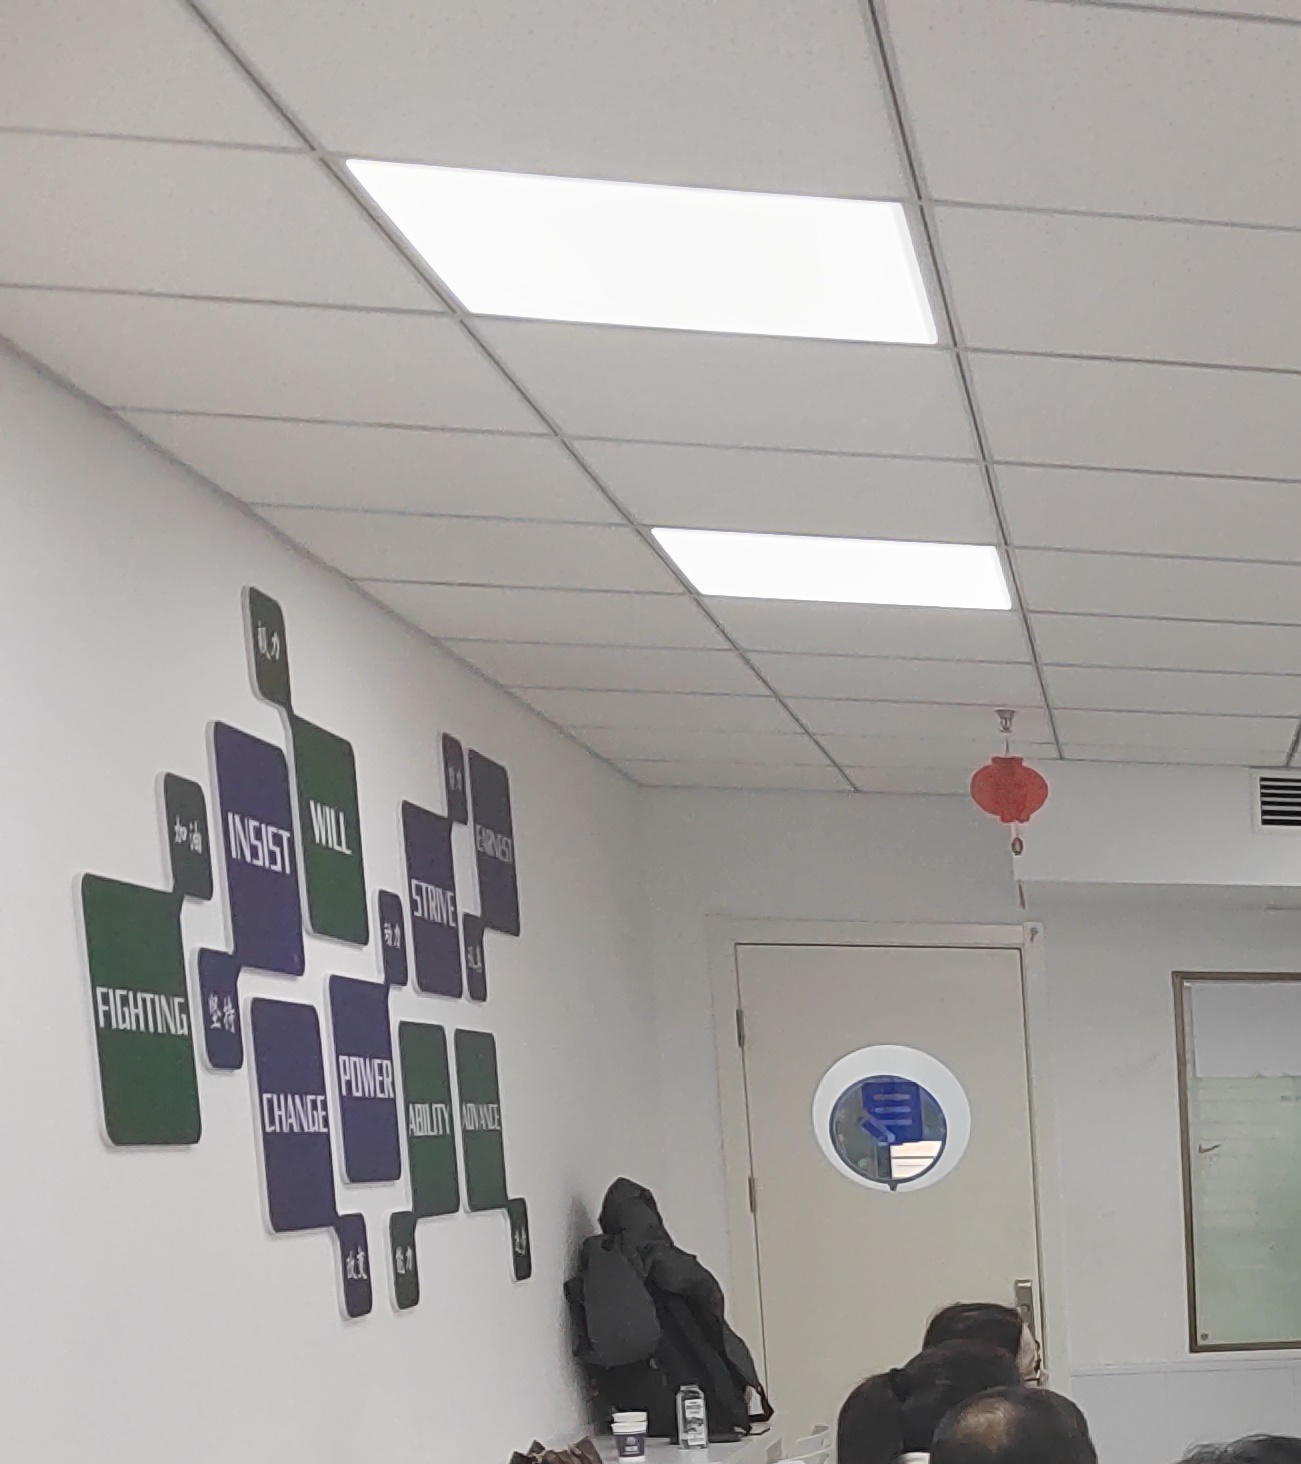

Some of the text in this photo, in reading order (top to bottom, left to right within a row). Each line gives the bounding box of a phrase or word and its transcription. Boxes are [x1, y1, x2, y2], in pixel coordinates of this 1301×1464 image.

[227, 811, 291, 875] INSIST
[309, 799, 353, 855] WILL
[411, 878, 457, 928] STRIVE
[95, 985, 190, 1037] FIGHTING
[338, 1054, 395, 1099] POWER
[262, 1093, 329, 1134] CHANGE
[408, 1103, 451, 1137] ABILITY
[461, 1102, 501, 1131] ADVANCE
